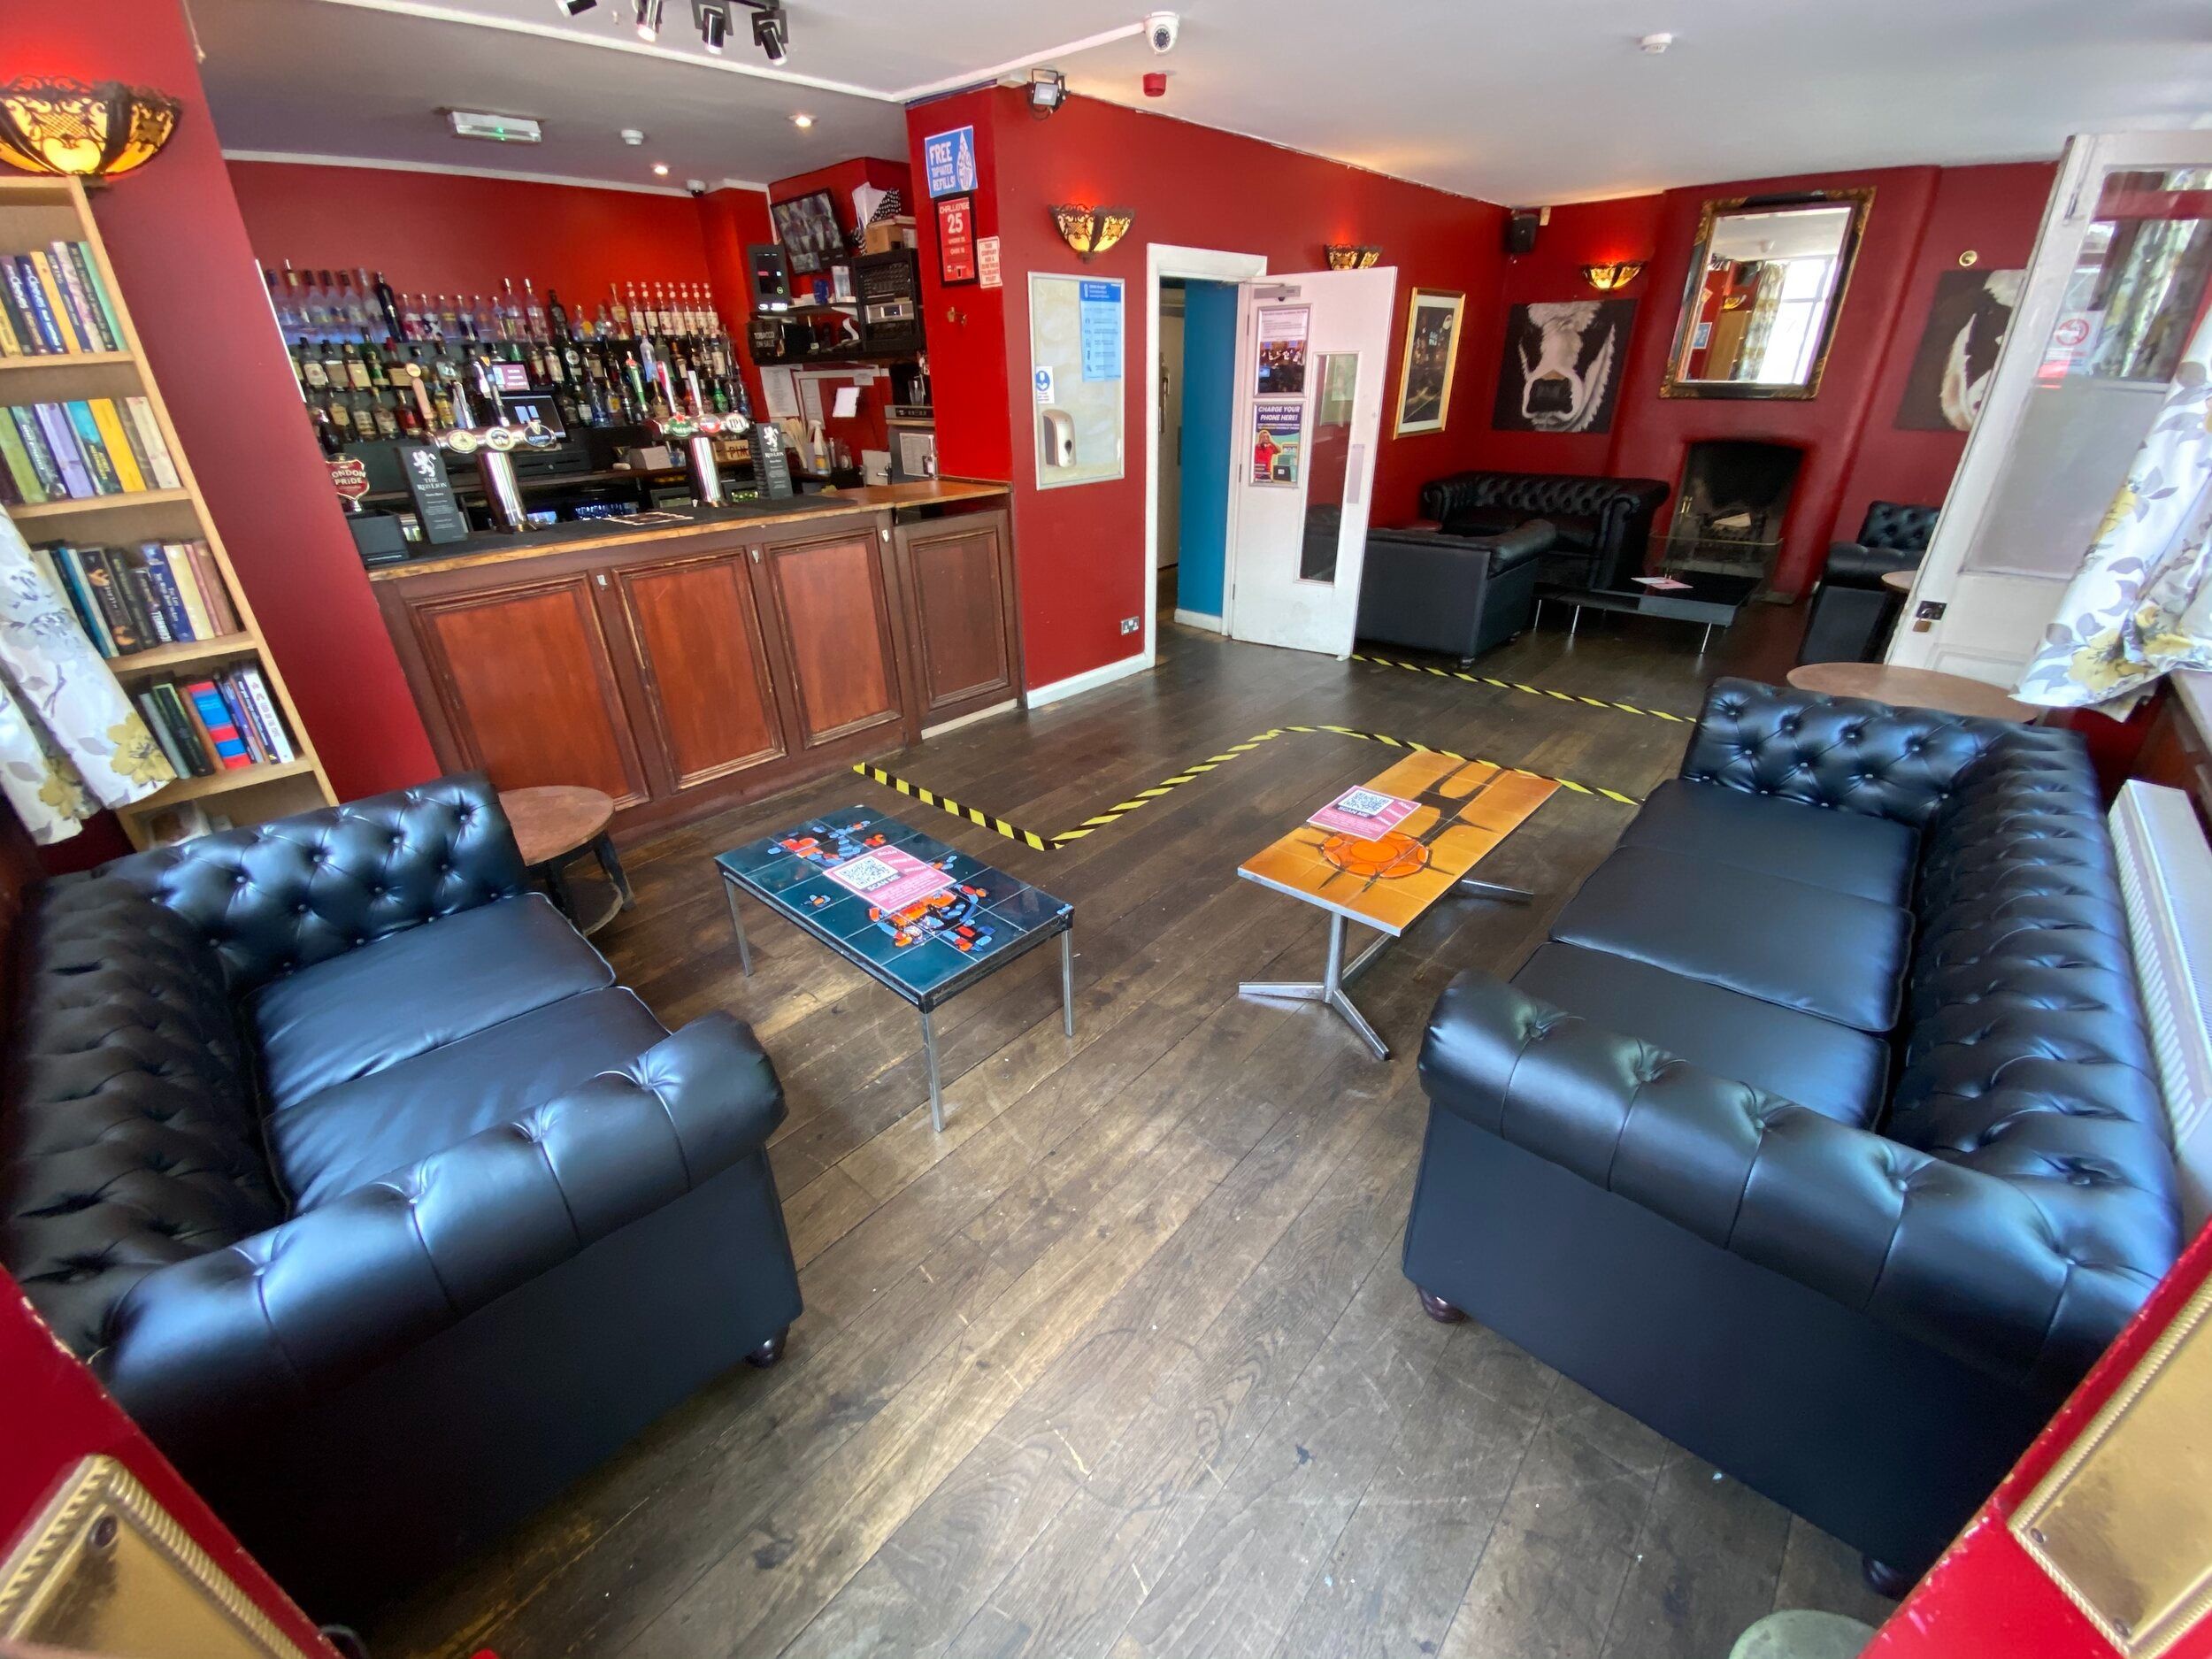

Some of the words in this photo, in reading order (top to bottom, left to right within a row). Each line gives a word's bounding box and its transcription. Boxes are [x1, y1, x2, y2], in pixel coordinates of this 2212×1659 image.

[930, 142, 952, 165] FREE
[940, 202, 970, 214] CHALLENGE
[948, 212, 963, 234] 25
[730, 419, 744, 429] IPA
[331, 469, 366, 479] ONDON
[1338, 806, 1357, 815] SCAN
[867, 879, 888, 892] SCAN
